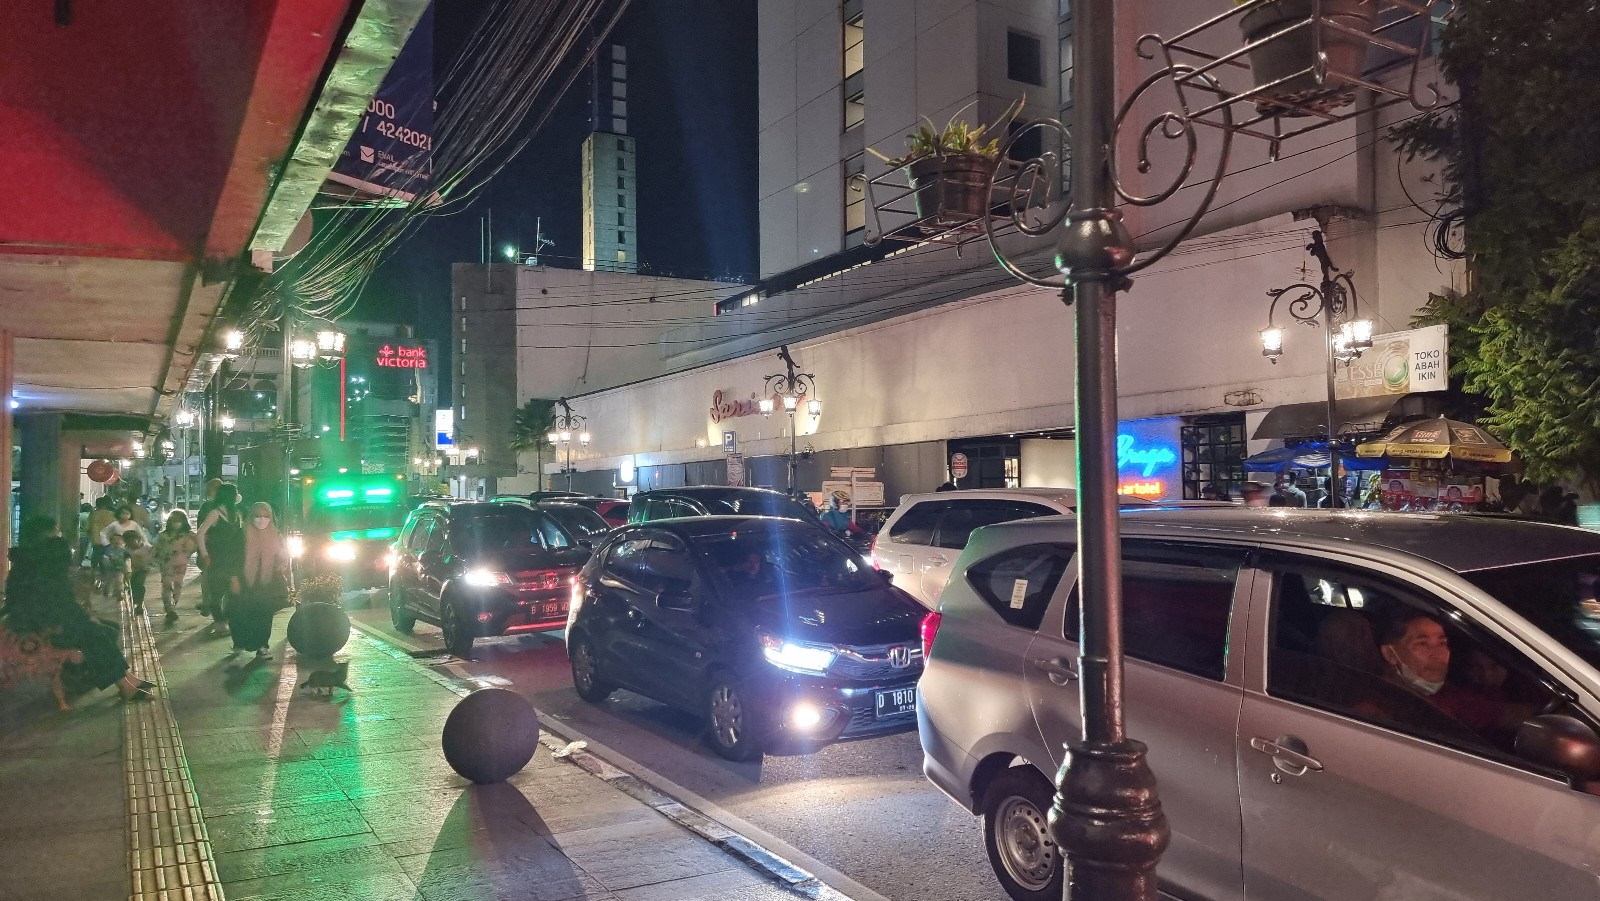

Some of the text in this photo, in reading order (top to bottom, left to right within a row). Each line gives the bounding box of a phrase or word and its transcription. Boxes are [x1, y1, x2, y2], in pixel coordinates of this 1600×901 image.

[398, 346, 425, 357] bank
[1415, 350, 1440, 360] TOKO
[377, 357, 427, 369] victoria
[1415, 361, 1440, 371] ABAH
[1418, 371, 1436, 381] IKIN
[725, 433, 733, 446] P
[879, 690, 913, 708] D 1810
